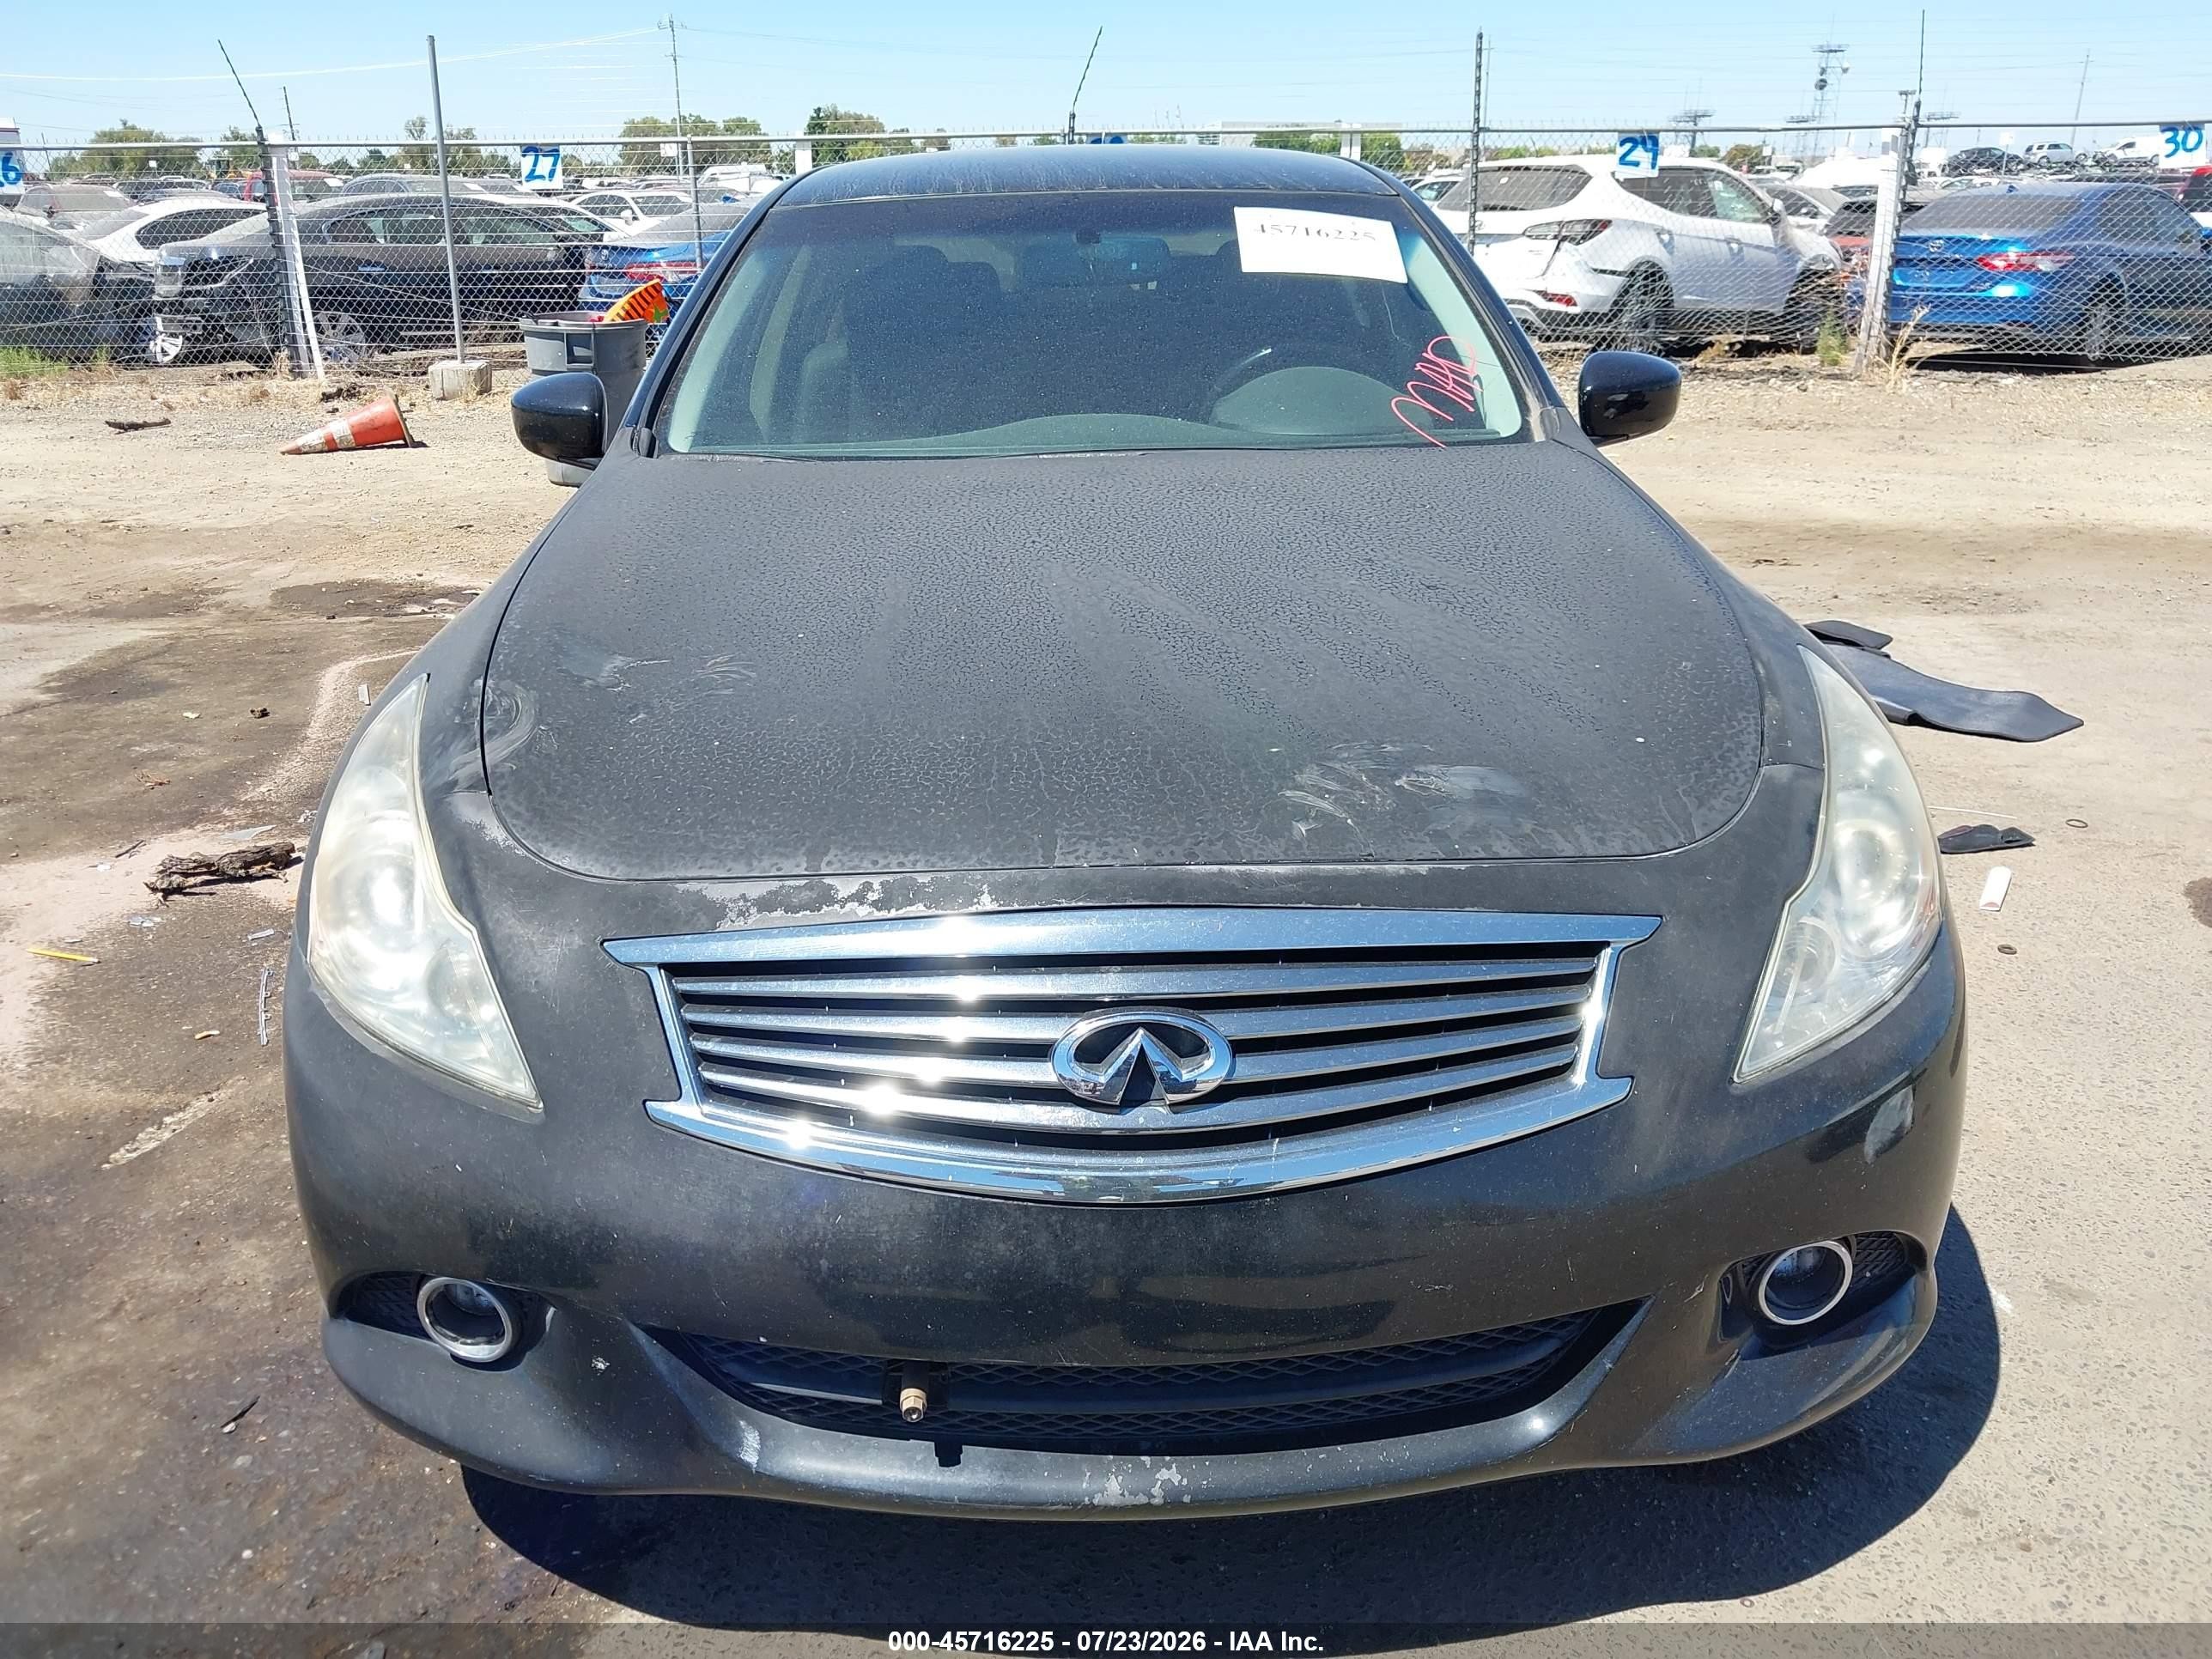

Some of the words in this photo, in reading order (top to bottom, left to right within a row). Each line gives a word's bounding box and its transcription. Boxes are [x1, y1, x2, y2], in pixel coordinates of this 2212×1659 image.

[1619, 135, 1658, 169] 29
[2160, 126, 2203, 158] 30
[0, 151, 21, 187] 6
[521, 145, 560, 182] 27
